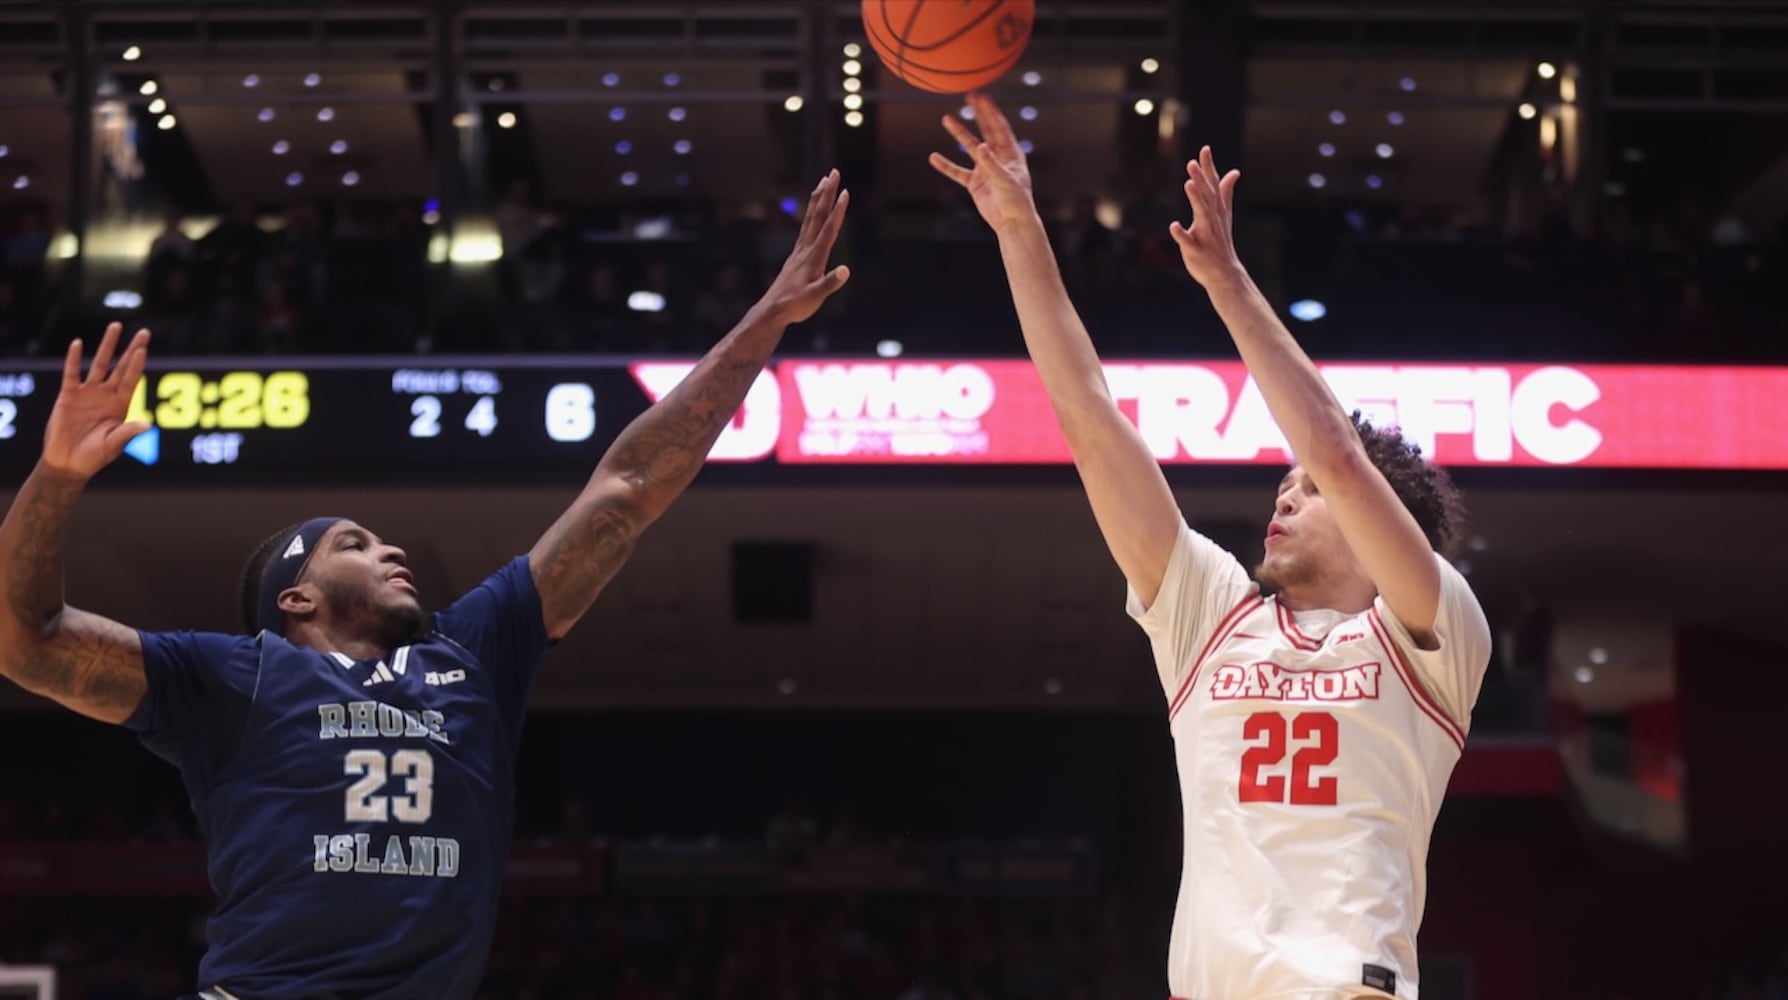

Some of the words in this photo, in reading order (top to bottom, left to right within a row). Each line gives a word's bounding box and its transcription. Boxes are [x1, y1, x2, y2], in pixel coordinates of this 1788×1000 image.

[124, 371, 310, 429] 13:26
[409, 395, 442, 438] 2
[464, 395, 498, 437] 4
[545, 383, 596, 442] 6
[1210, 662, 1381, 701] DAYTON
[318, 700, 451, 745] RHODE
[1239, 711, 1339, 806] 22
[344, 749, 434, 823] 23
[313, 833, 460, 878] ISLAND
